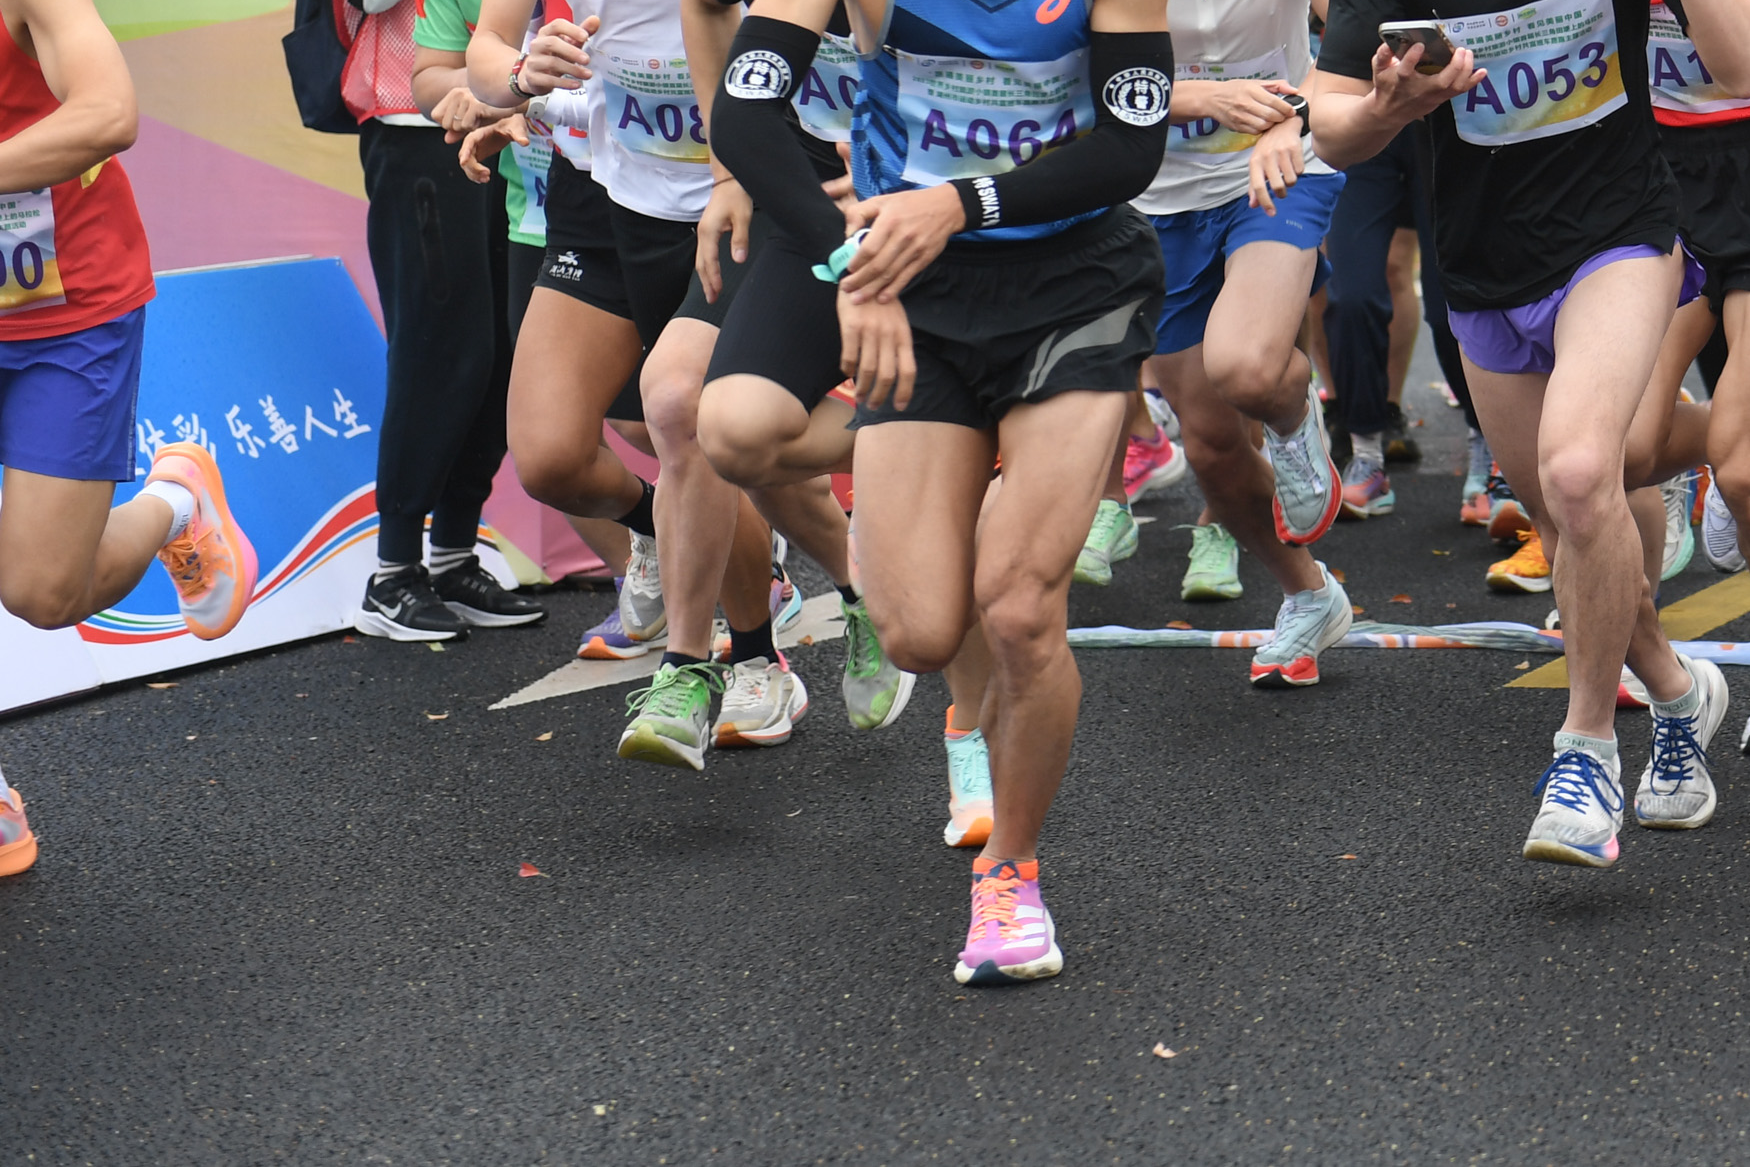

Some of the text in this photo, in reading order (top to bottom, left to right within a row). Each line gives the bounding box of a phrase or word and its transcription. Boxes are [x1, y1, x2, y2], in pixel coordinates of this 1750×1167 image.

[1466, 42, 1608, 115] A053
[224, 387, 372, 460] 乐善人生
